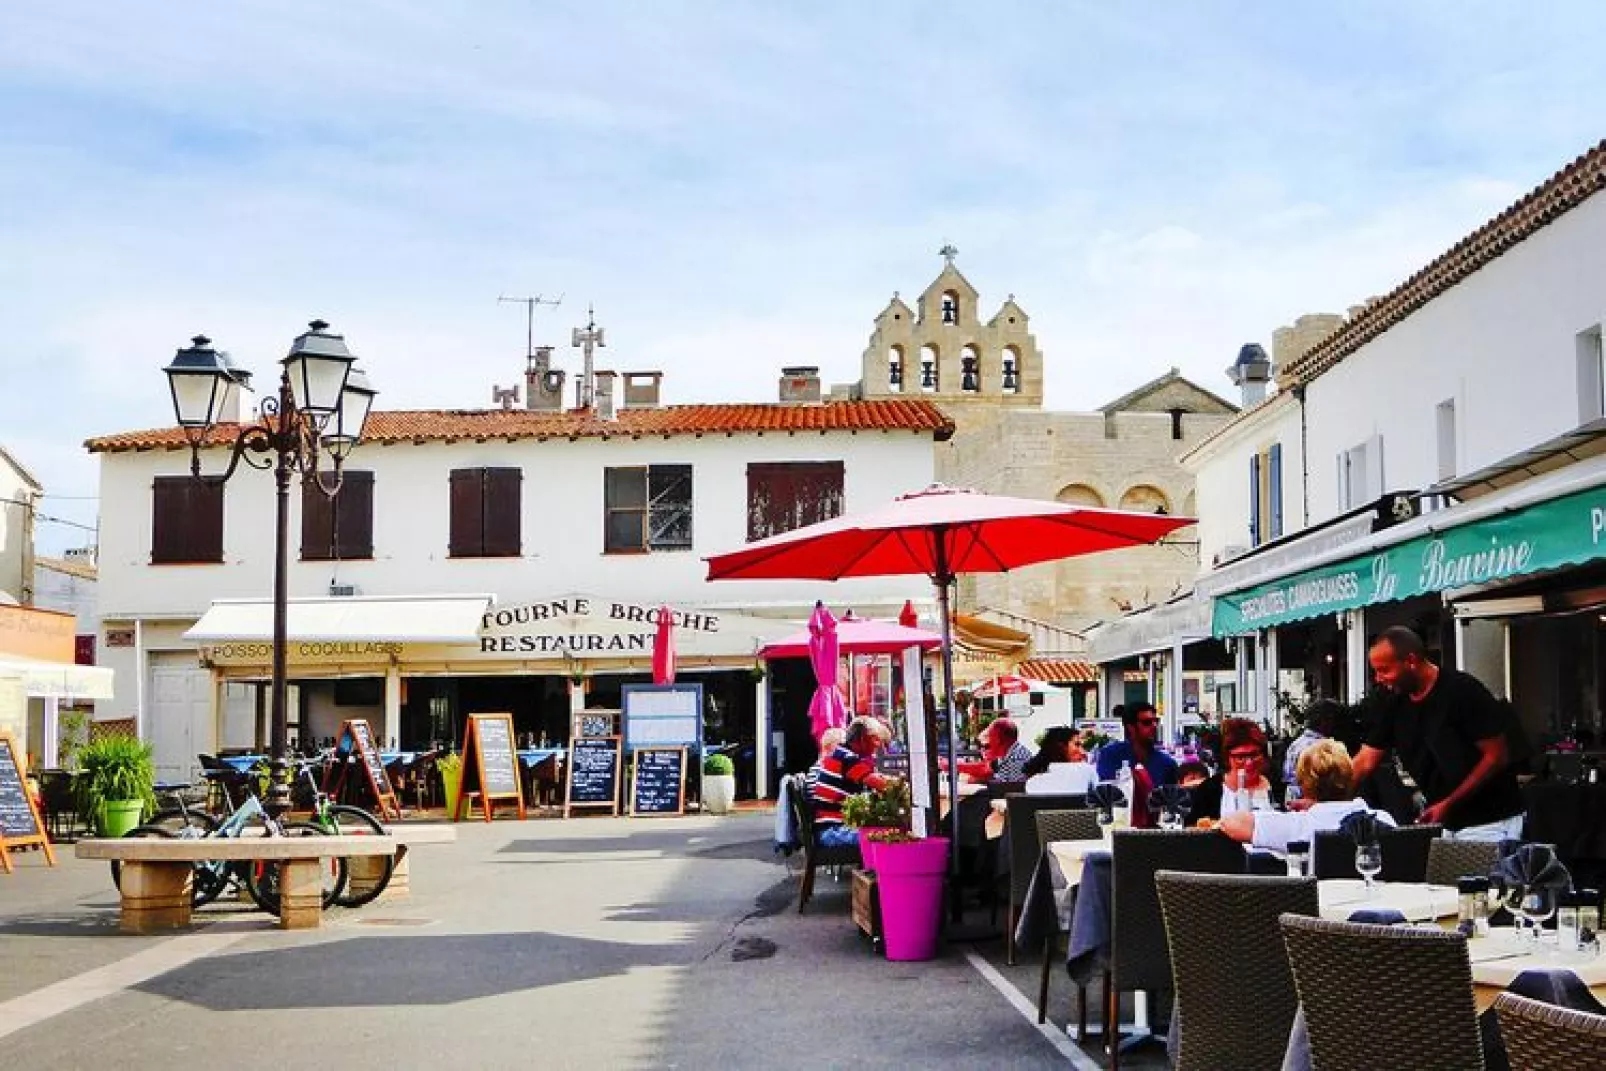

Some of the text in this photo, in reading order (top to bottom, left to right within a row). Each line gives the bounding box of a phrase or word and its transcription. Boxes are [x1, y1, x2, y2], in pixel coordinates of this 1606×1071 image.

[1591, 507, 1606, 545] P
[1370, 554, 1397, 602] La
[482, 598, 590, 630] TOURNE
[213, 643, 276, 658] POISSO
